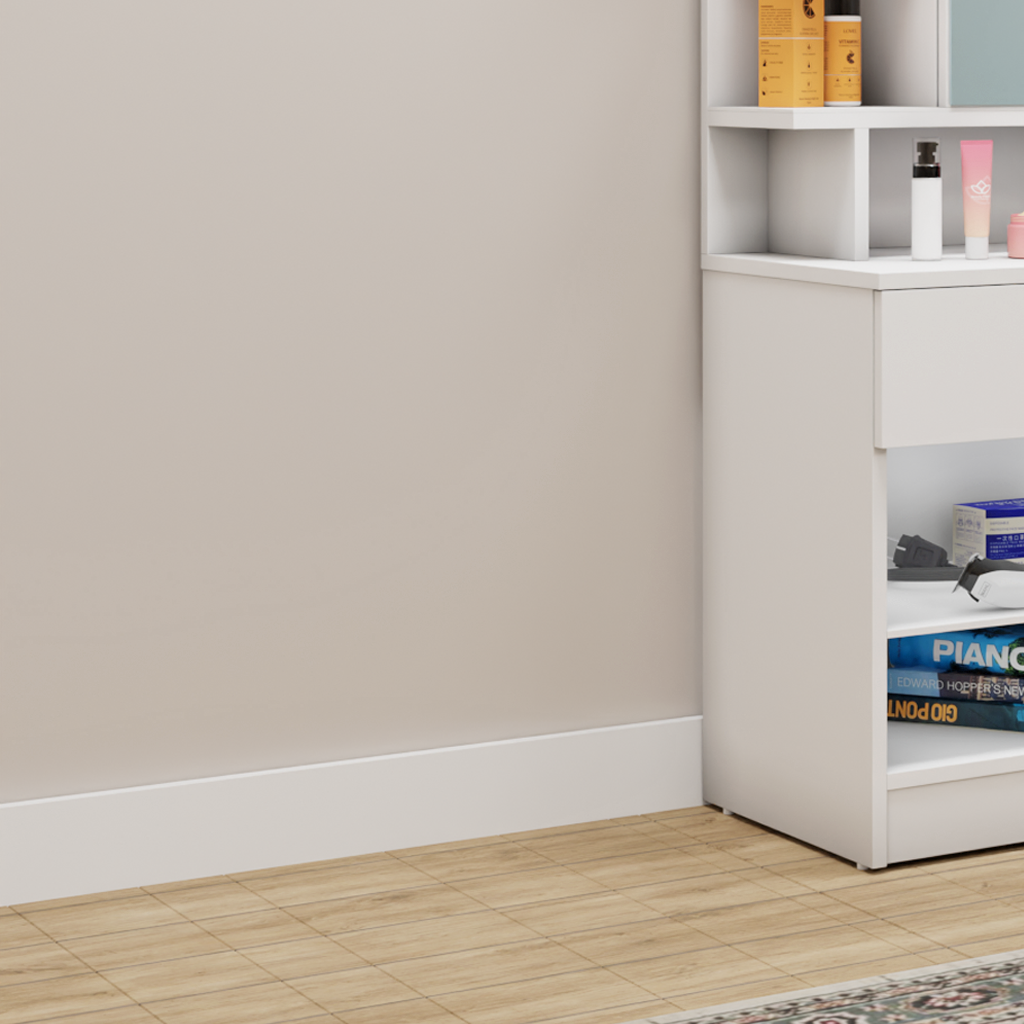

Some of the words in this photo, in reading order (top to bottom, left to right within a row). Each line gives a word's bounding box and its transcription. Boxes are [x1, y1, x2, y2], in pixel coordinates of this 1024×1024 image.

[897, 676, 945, 690] EDWARD
[946, 680, 1001, 695] HOPPER'S
[930, 702, 958, 723] GIO
